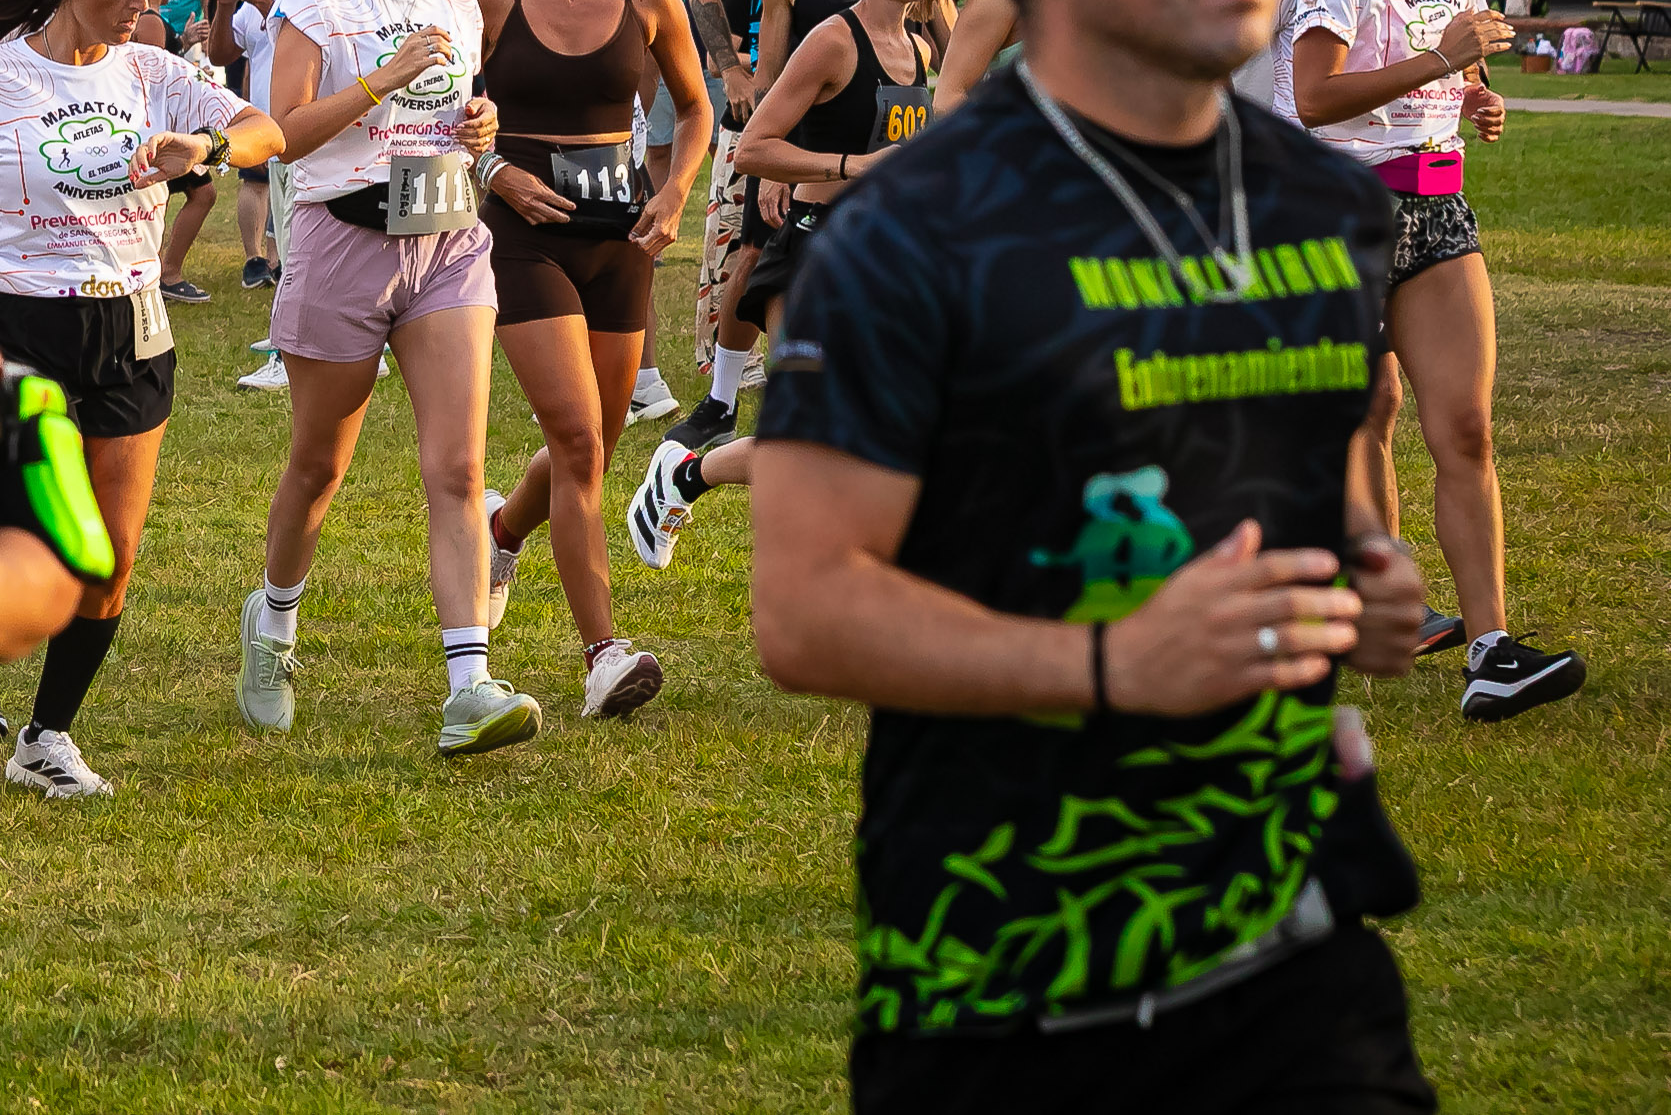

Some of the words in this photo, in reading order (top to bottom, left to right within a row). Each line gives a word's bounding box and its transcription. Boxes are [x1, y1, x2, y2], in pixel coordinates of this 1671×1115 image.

[376, 22, 432, 42] MARAT
[40, 101, 132, 128] MARATÓN
[73, 123, 104, 142] ATLETAS
[390, 139, 418, 147] ANCOR
[88, 169, 96, 178] EL
[98, 160, 123, 176] TREBOL
[53, 181, 136, 201] ANIVERSARI
[398, 168, 411, 218] TIEMPO
[411, 167, 465, 214] 111
[576, 163, 631, 203] 113
[30, 210, 117, 230] Prevención
[119, 206, 158, 224] Salud
[58, 231, 69, 240] de
[80, 274, 125, 297] don
[136, 292, 150, 343] TIEMPO
[1113, 337, 1370, 411] Entrenamientos
